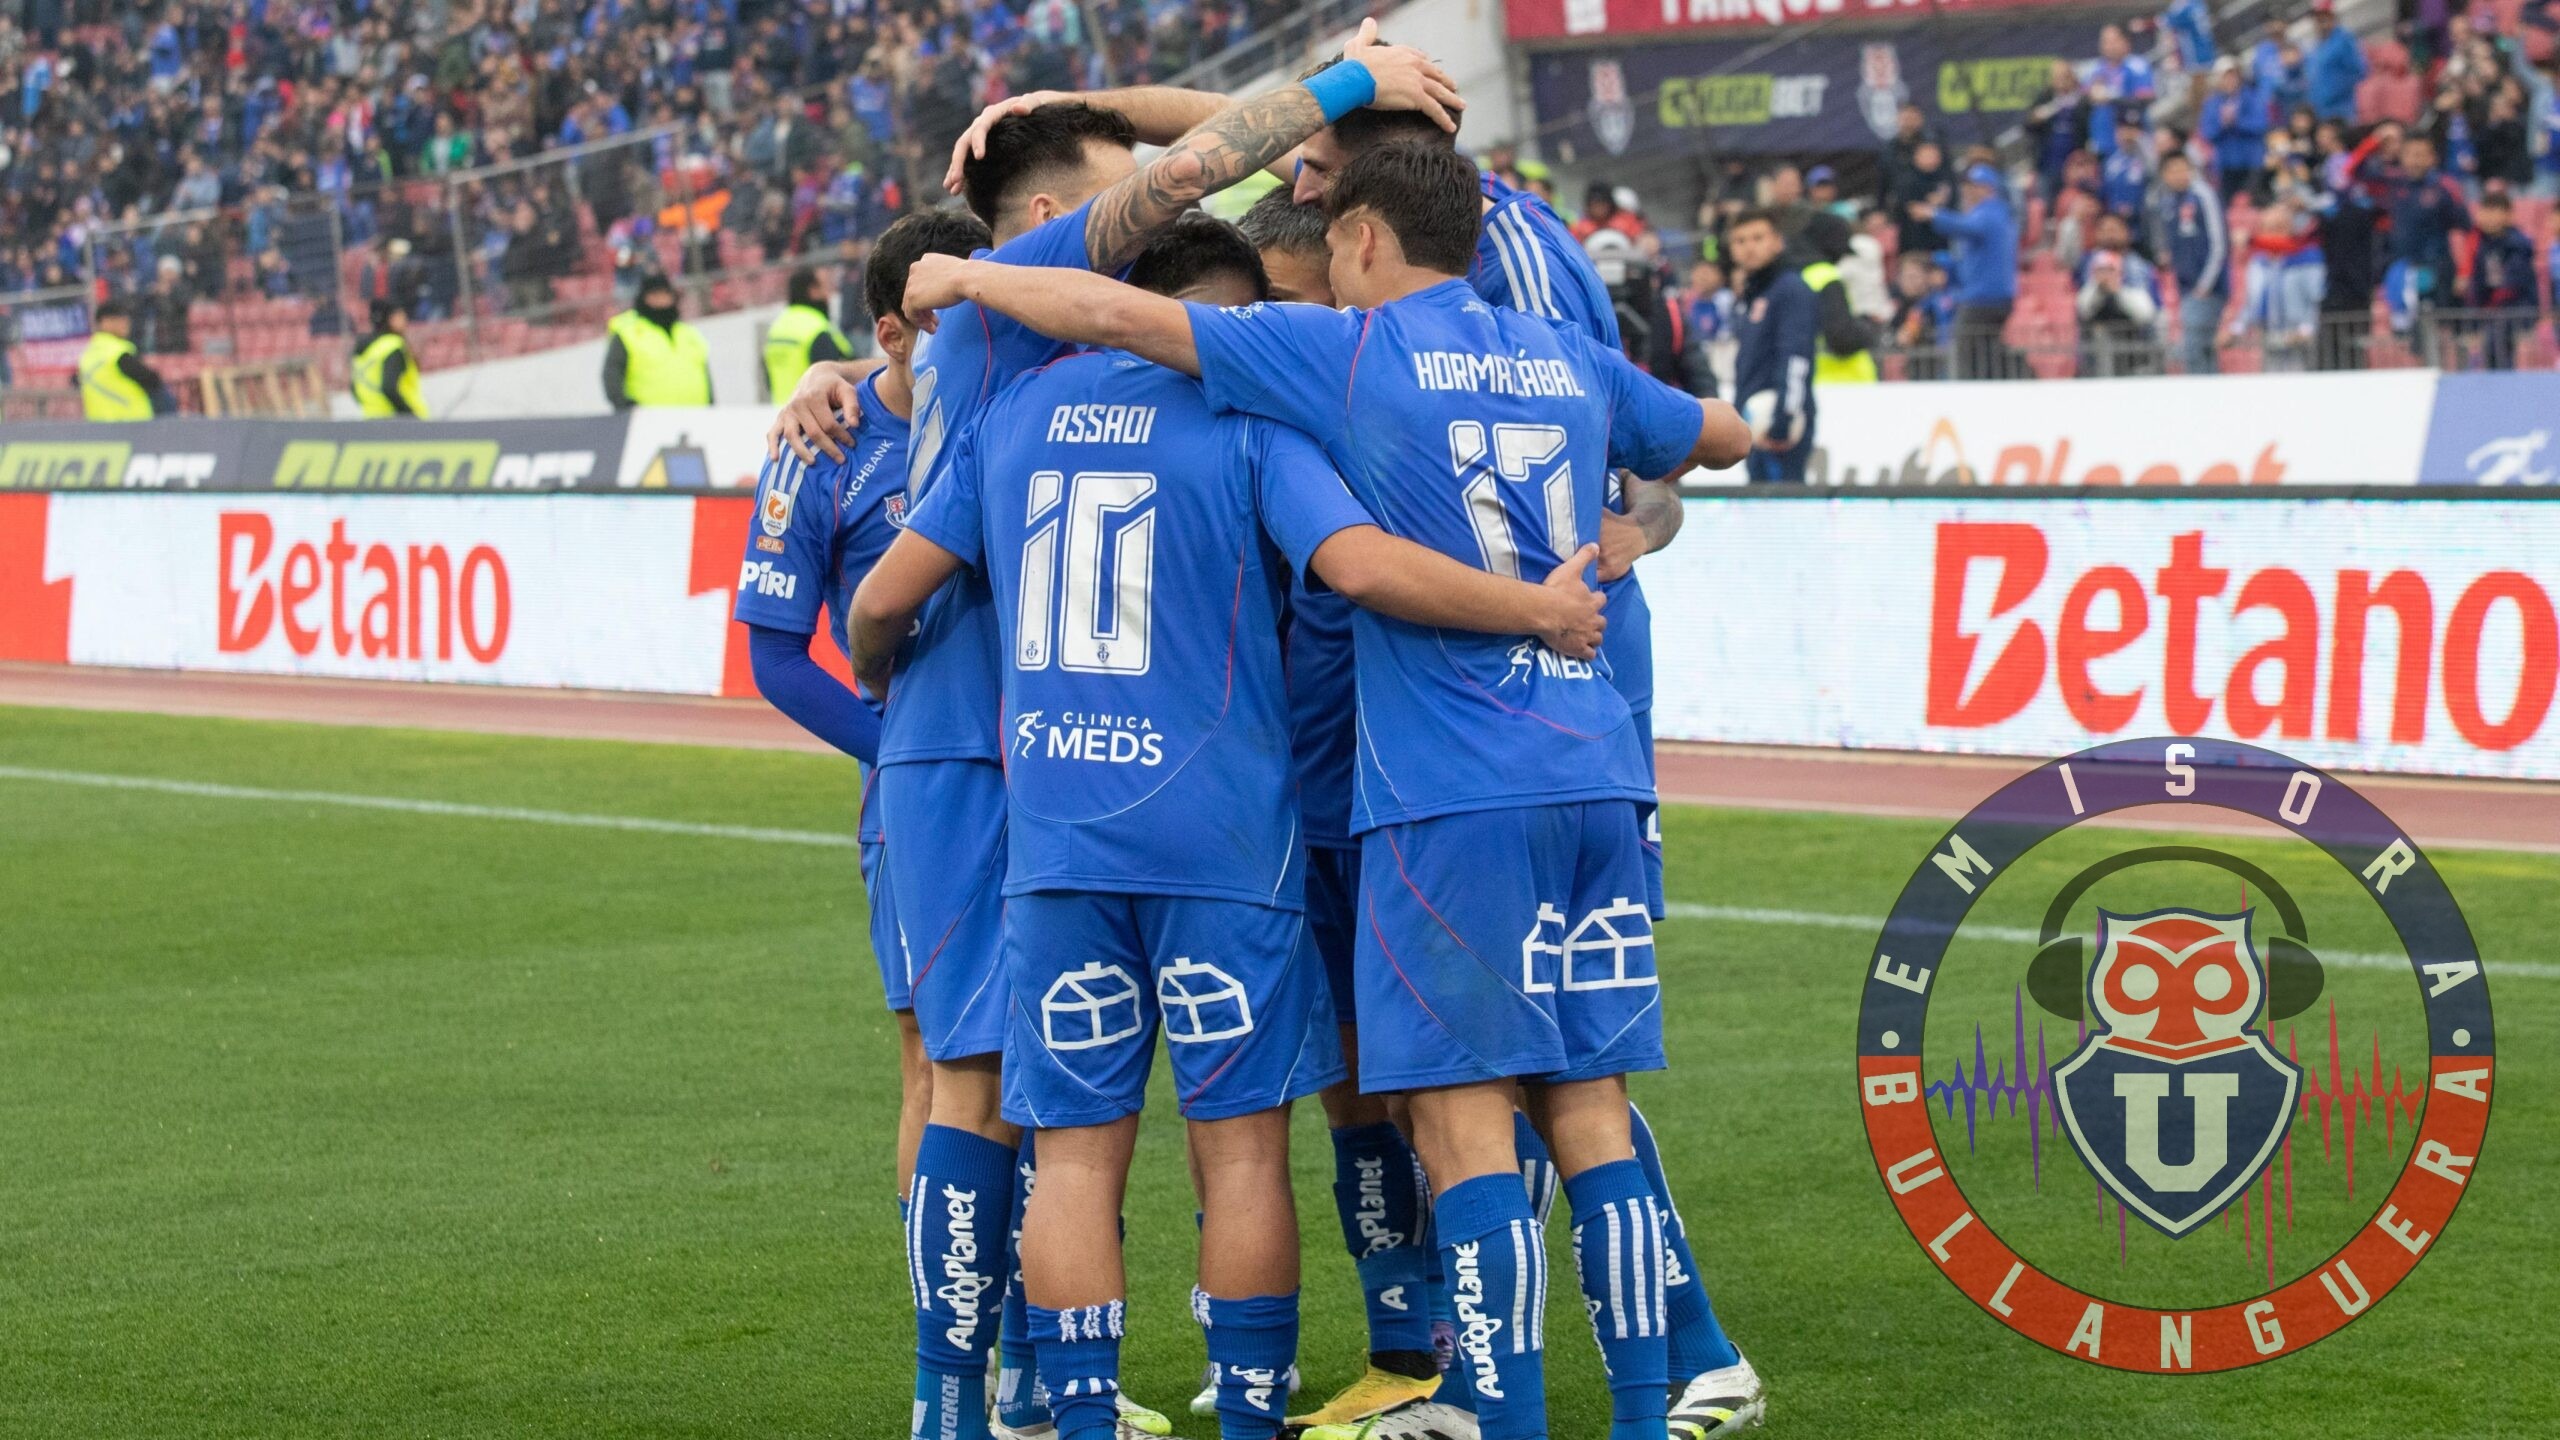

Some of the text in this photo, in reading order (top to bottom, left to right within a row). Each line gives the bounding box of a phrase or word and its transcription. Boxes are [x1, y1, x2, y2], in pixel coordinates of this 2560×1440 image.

[841, 439, 894, 511] MACHBANK
[1047, 404, 1157, 444] ASSADI
[1448, 420, 1578, 580] 17
[218, 512, 512, 664] Betano
[1015, 470, 1157, 676] 10
[1926, 522, 2560, 751] Betano
[1062, 711, 1153, 730] CLINICA
[1536, 649, 1601, 680] MED
[1047, 726, 1164, 766] MEDS
[937, 1183, 994, 1352] AutoPlanet
[1452, 1239, 1504, 1398] AutoPlane
